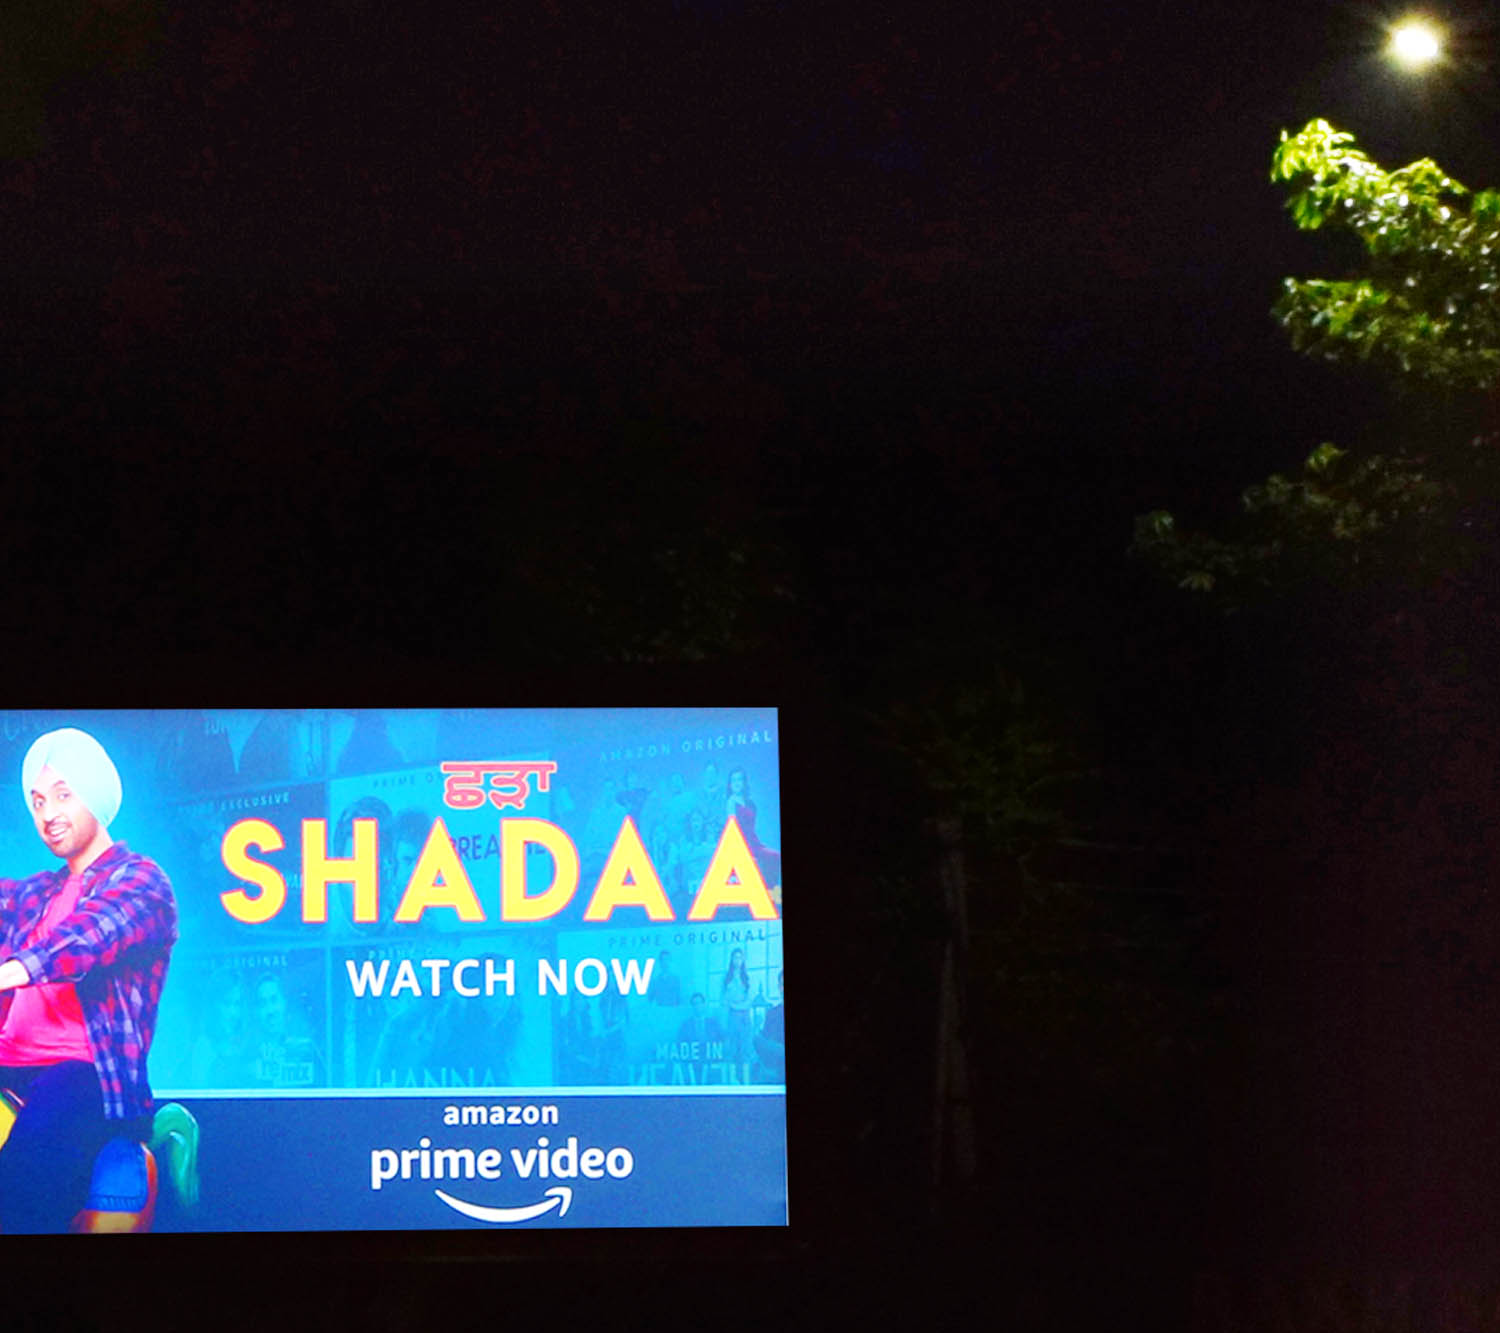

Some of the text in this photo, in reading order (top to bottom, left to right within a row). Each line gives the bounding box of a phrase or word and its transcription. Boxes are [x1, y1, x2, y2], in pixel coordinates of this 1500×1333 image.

[681, 729, 773, 752] ORIGINAL
[219, 815, 782, 924] SHADAA
[673, 928, 767, 947] ORIGINAL
[345, 957, 655, 998] WATCH NOW
[705, 1040, 724, 1060] IN
[442, 1104, 560, 1126] amazon
[370, 1137, 634, 1190] prime video
